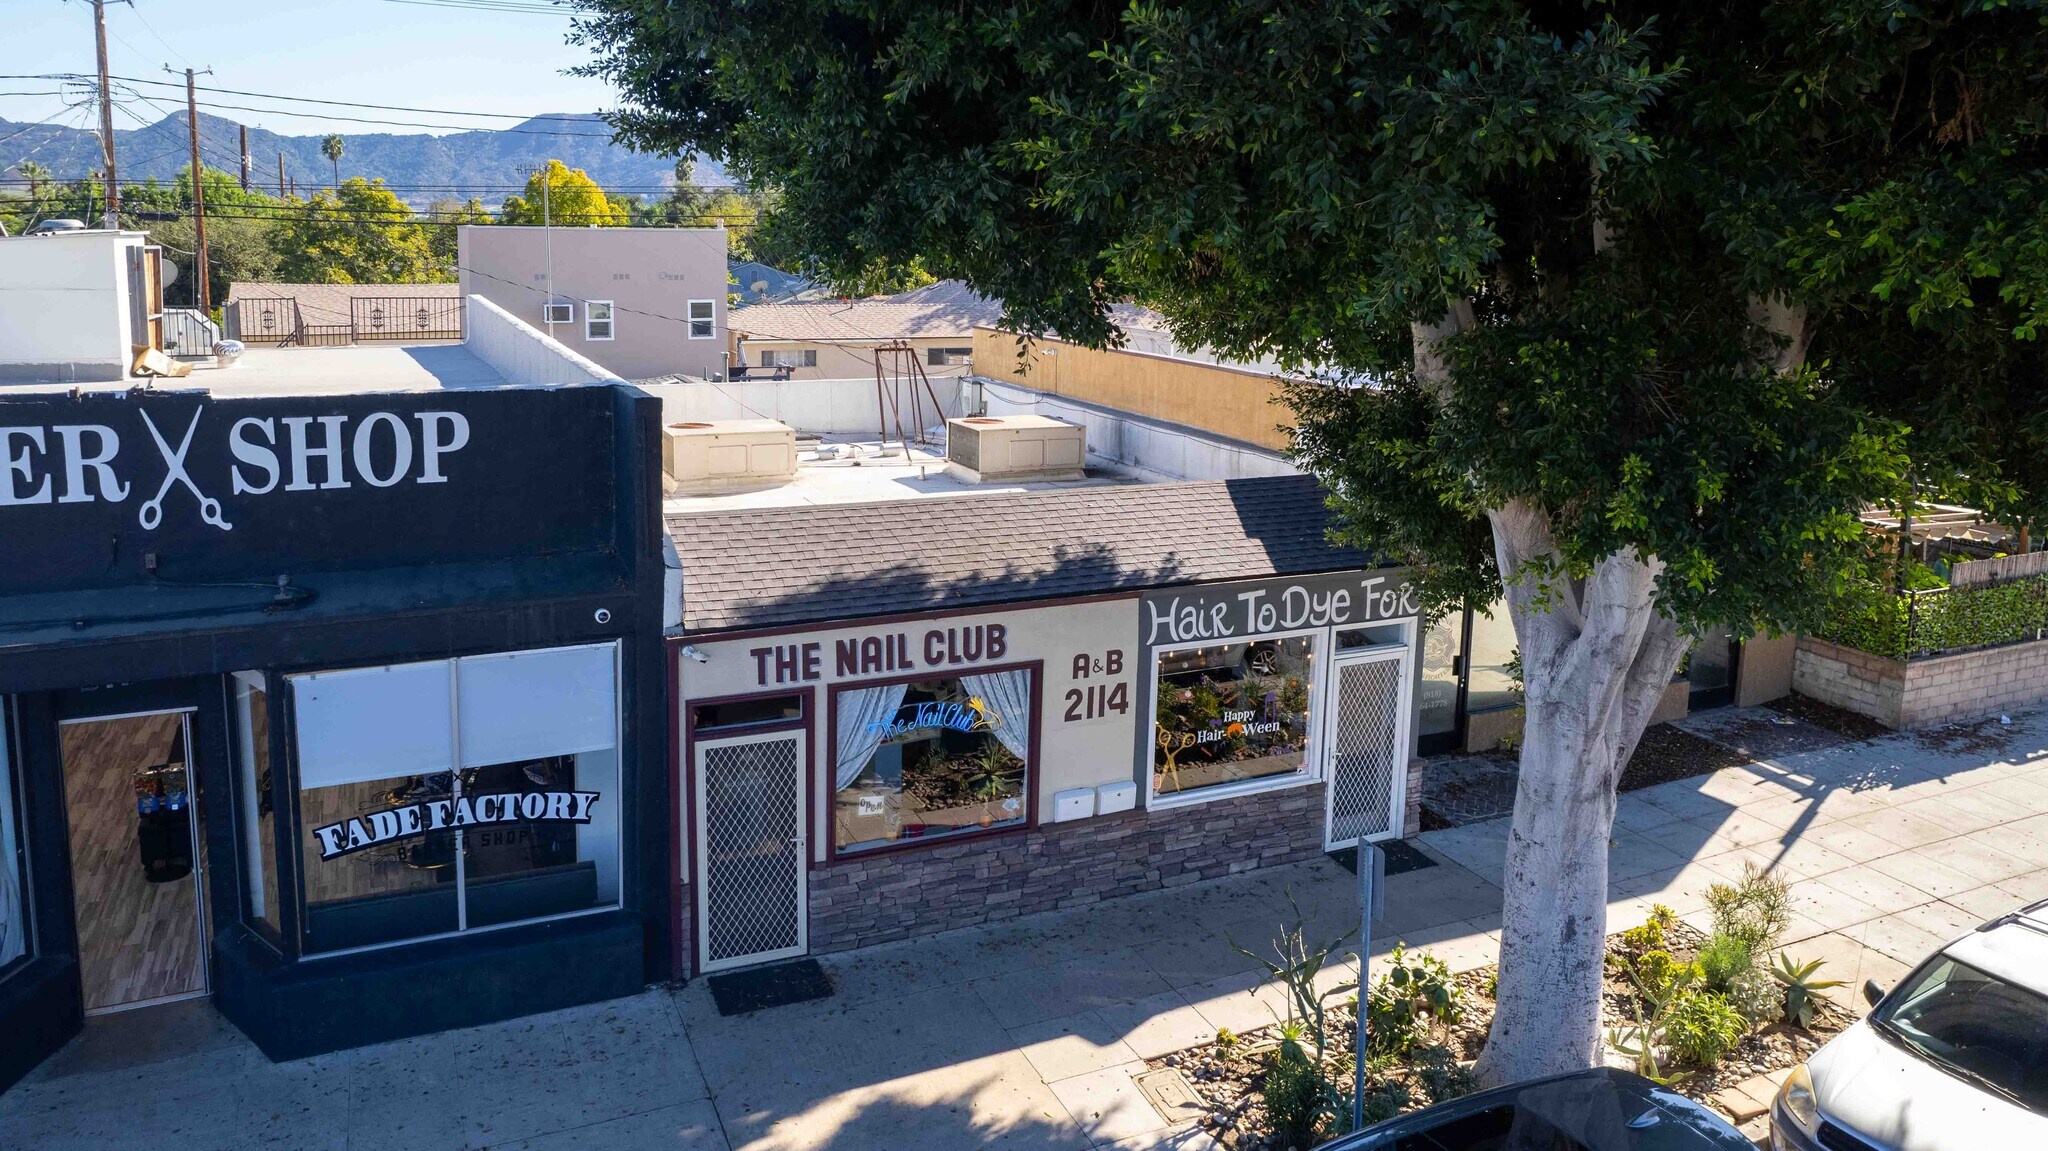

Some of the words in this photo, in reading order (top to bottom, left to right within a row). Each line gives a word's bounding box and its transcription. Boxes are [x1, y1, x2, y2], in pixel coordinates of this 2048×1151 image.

[0, 425, 131, 505] ER
[229, 411, 470, 495] SHOP
[1238, 589, 1277, 633] To
[1279, 586, 1350, 629] Dye
[750, 641, 821, 687] THE
[835, 633, 914, 677] NAIL
[924, 623, 1008, 666] CLUB
[1072, 649, 1124, 680] A&B
[866, 710, 908, 739] The
[908, 702, 944, 731] Nail
[944, 703, 974, 733] Club
[1063, 682, 1129, 723] 2114
[1223, 710, 1256, 723] Happy
[315, 804, 423, 857] FADE
[428, 791, 598, 830] FACTORY
[860, 798, 883, 813] Open
[481, 831, 528, 847] SHOP
